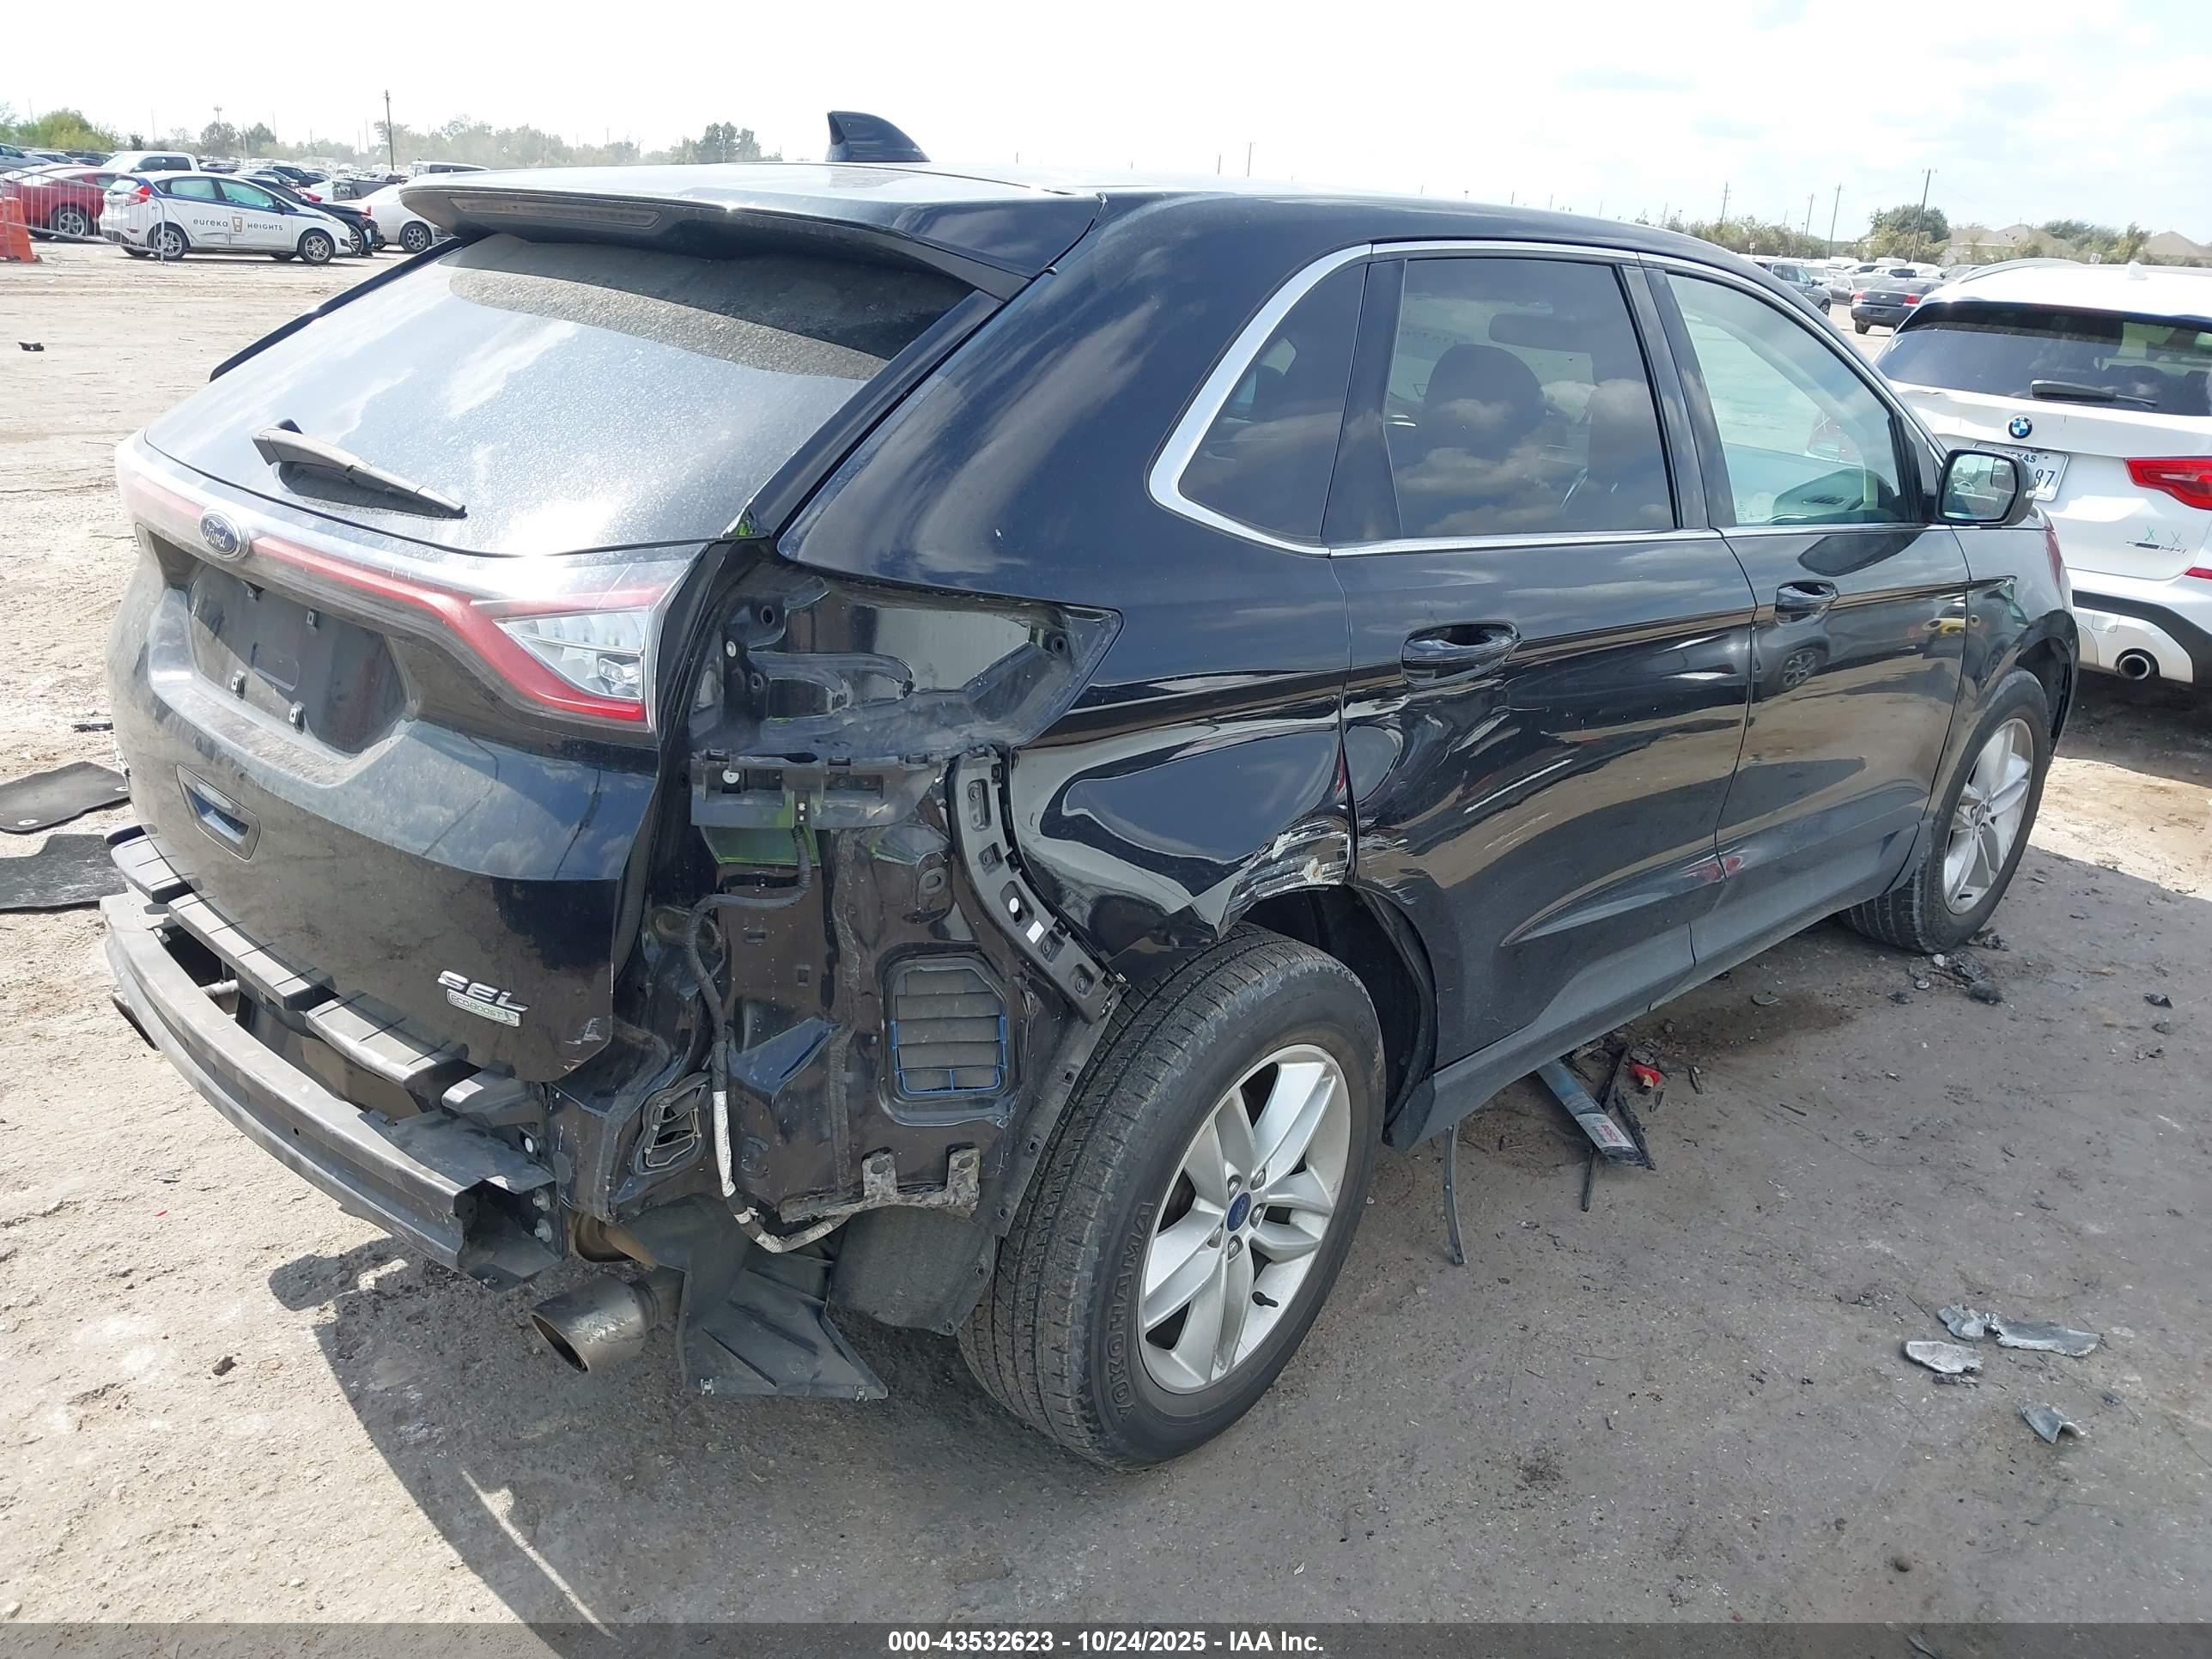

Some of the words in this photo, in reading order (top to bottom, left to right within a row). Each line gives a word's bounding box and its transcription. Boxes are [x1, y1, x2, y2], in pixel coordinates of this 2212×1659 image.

[205, 519, 228, 549] Ford
[437, 970, 530, 1012] SEL
[1108, 1202, 1155, 1421] YOKOHAMA
